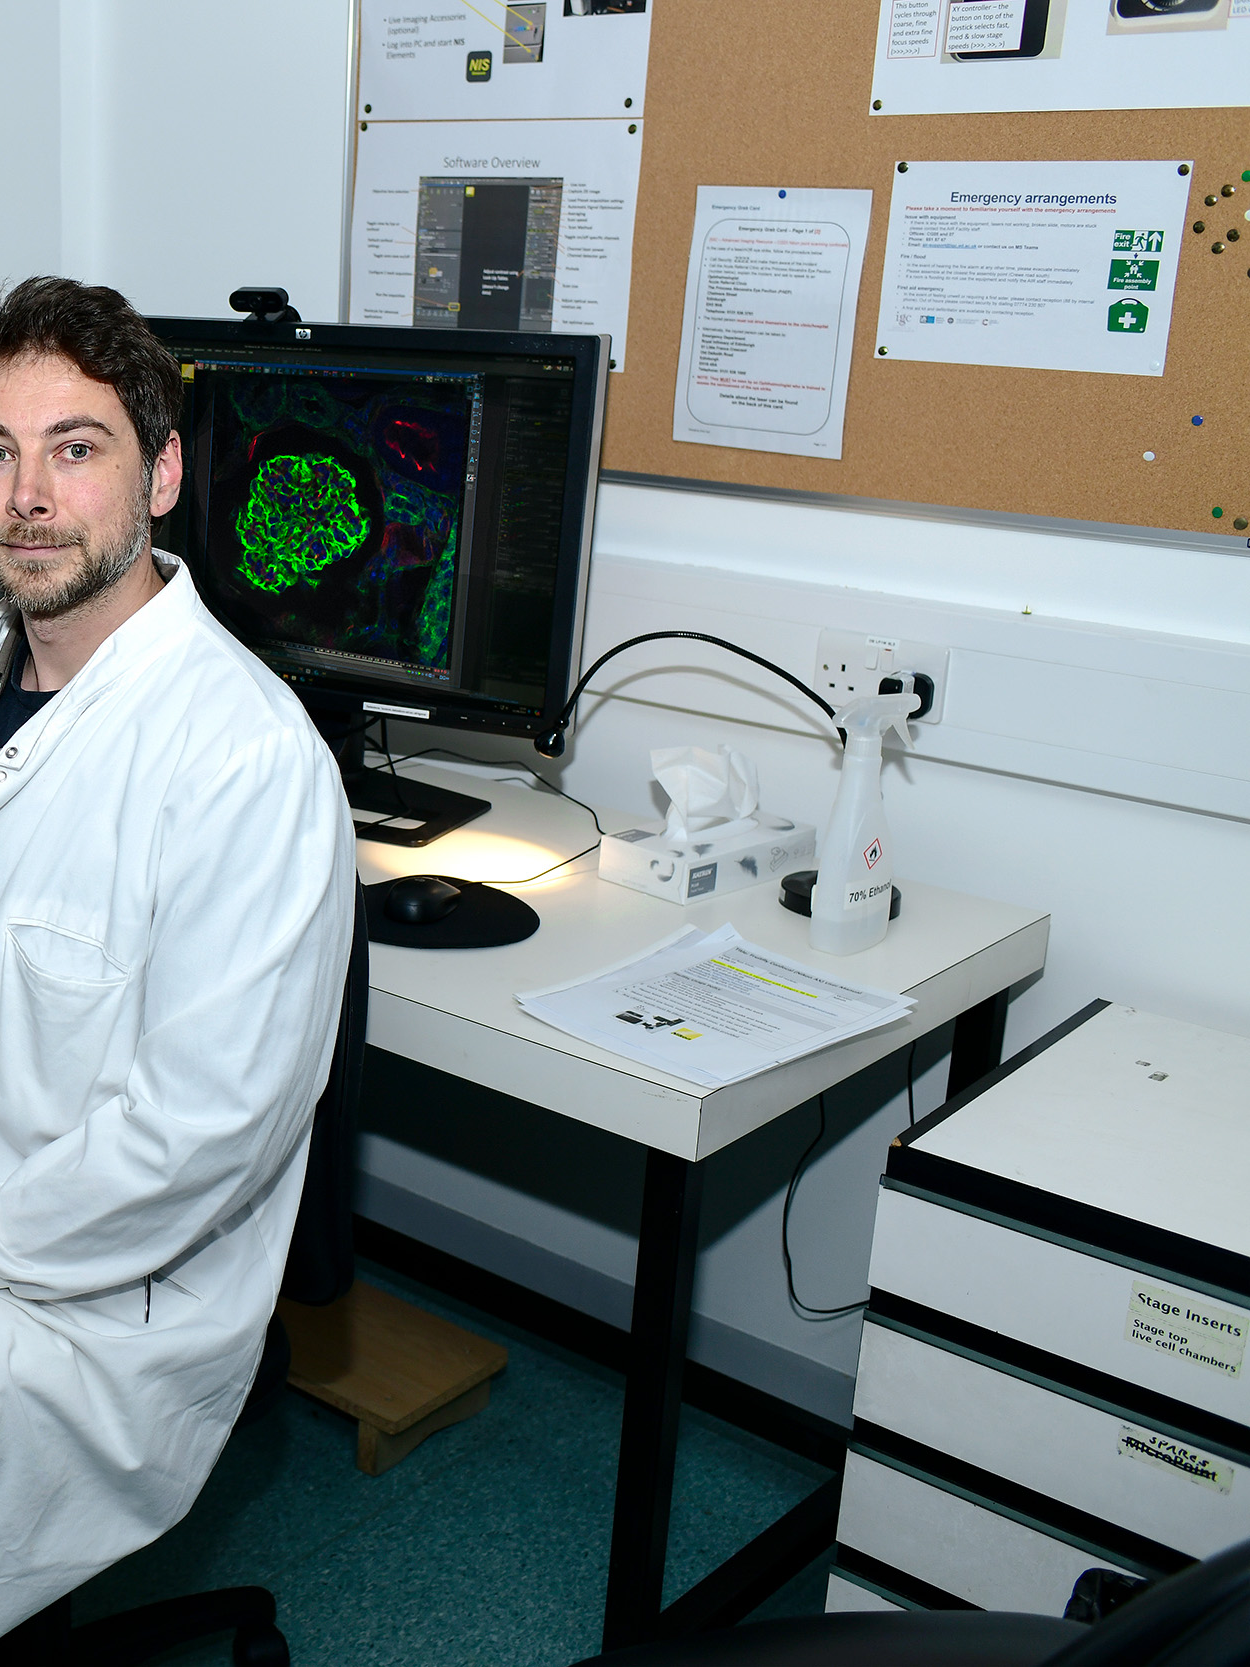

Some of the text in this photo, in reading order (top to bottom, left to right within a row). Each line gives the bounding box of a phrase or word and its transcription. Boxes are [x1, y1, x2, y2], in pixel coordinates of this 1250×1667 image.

[403, 16, 428, 24] Imaging
[430, 14, 466, 22] Accessories
[913, 10, 937, 18] through
[388, 26, 420, 36] (optional)
[950, 24, 973, 32] joystick
[986, 32, 1003, 40] stage
[387, 41, 398, 50] Log
[386, 51, 416, 60] Elements
[469, 58, 490, 72] NIS
[443, 156, 540, 169] Software Overview
[950, 192, 1117, 207] Emergency arrangements
[1114, 240, 1130, 248] exit
[896, 311, 911, 326] igc
[849, 890, 866, 903] 70%
[1138, 1292, 1242, 1337] Stage Inserts
[1133, 1318, 1188, 1344] Stage top
[1132, 1330, 1236, 1373] live cell chambers
[1125, 1436, 1218, 1482] MicroPoint
